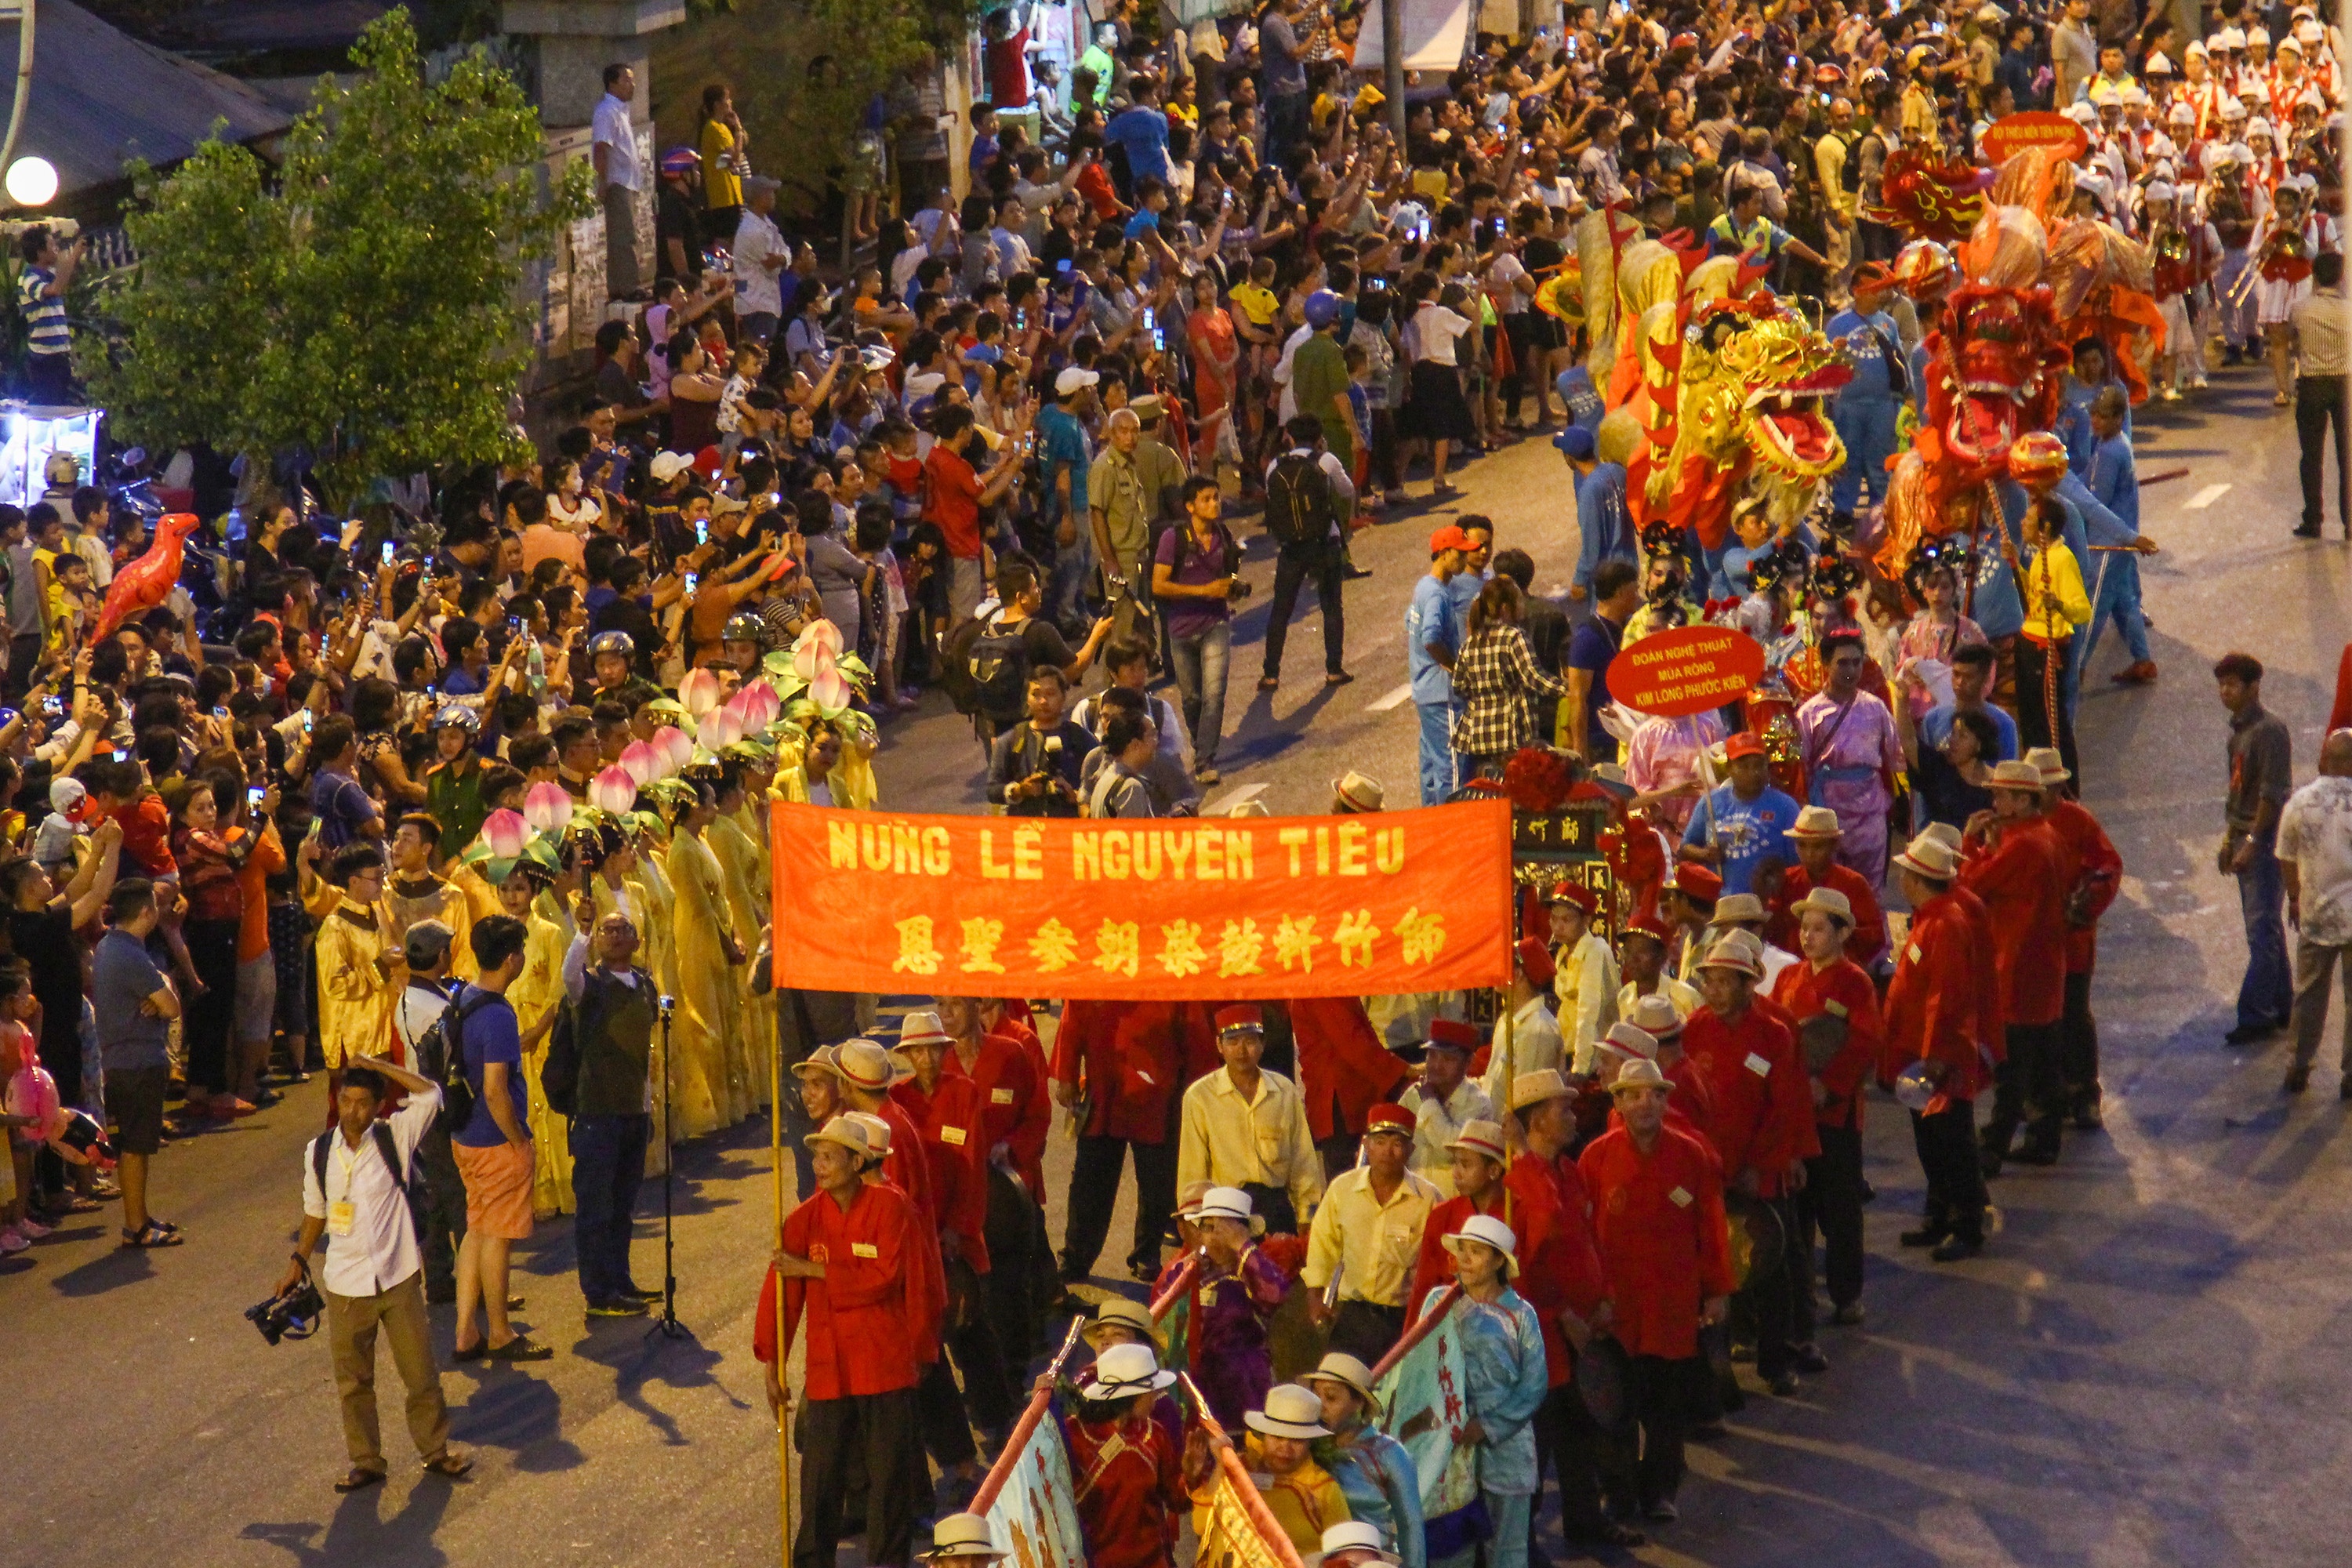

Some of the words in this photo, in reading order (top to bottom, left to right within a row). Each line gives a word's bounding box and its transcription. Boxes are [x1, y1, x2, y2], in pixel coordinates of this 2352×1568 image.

[1665, 643, 1696, 660] NGHỆ
[1635, 691, 1654, 707] KIM
[1656, 686, 1683, 704] LONG
[1072, 823, 1254, 881] NGUYÊN
[1279, 820, 1405, 877] TIÊU
